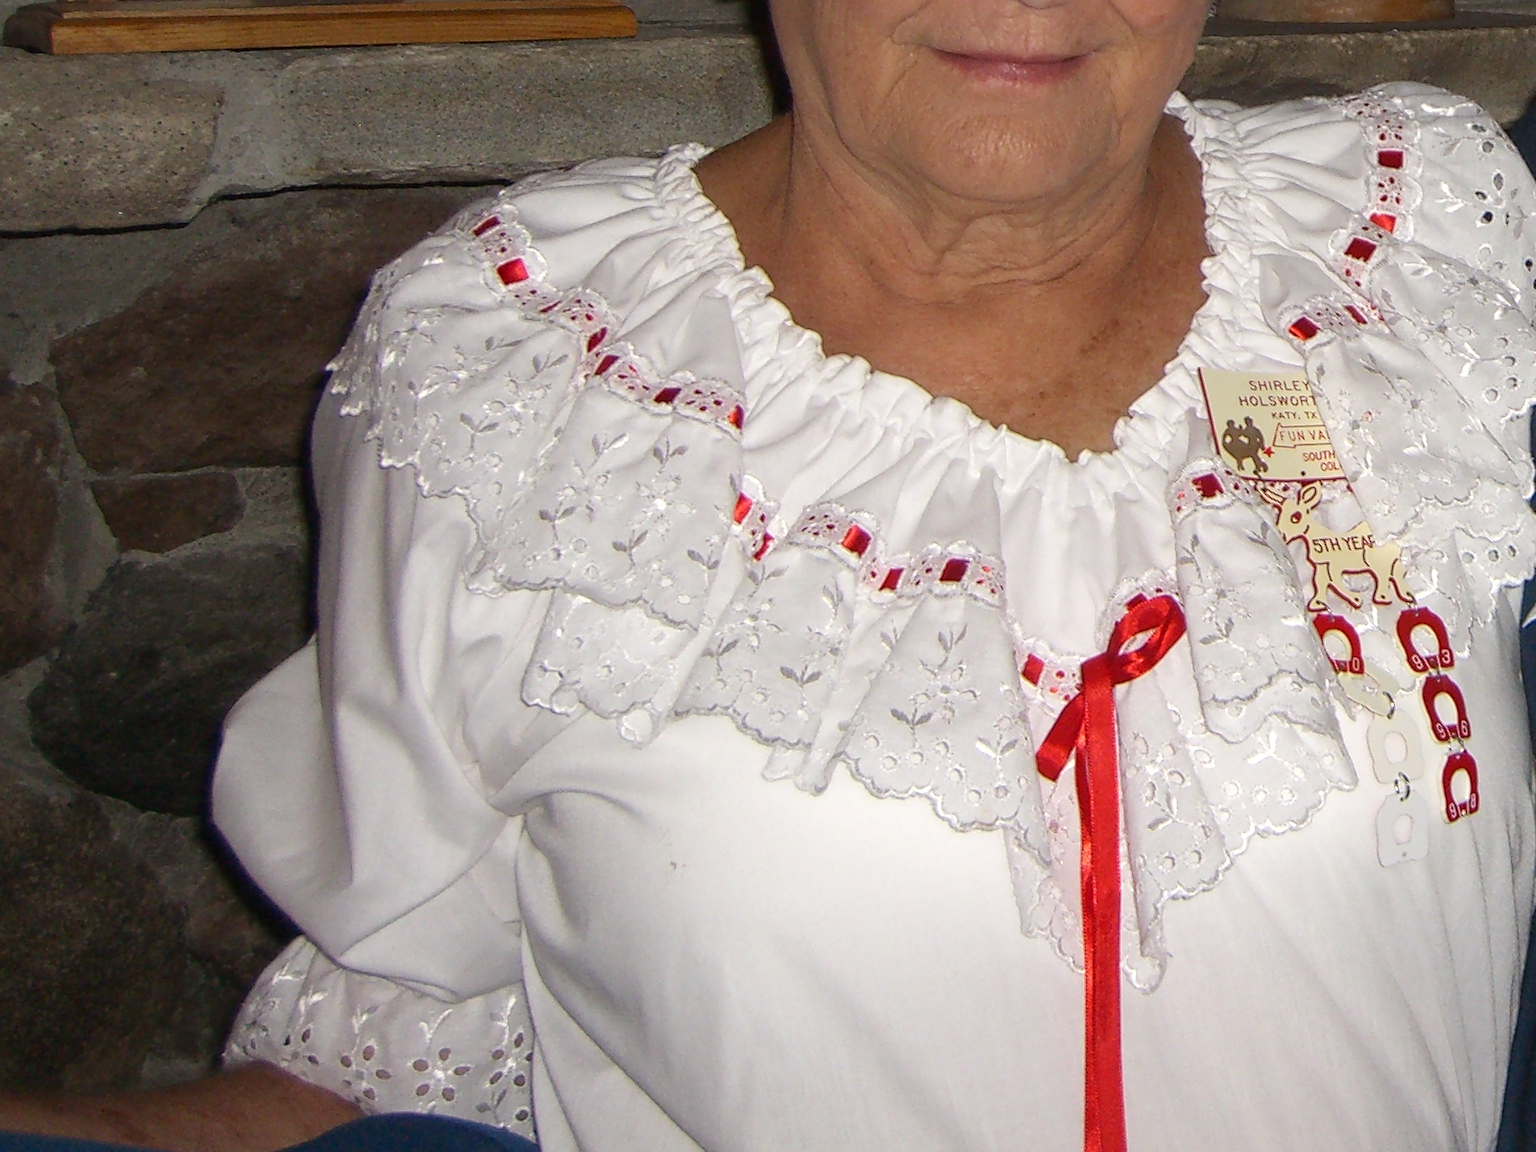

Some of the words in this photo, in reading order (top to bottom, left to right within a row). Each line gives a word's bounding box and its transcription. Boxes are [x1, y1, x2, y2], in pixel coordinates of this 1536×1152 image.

[1248, 380, 1310, 391] SHIRLEY
[1239, 395, 1317, 406] HOLSWORT
[1305, 411, 1317, 419] TX
[1279, 430, 1305, 441] FUN
[1303, 450, 1336, 462] SOUTH
[1312, 538, 1343, 554] 5TH
